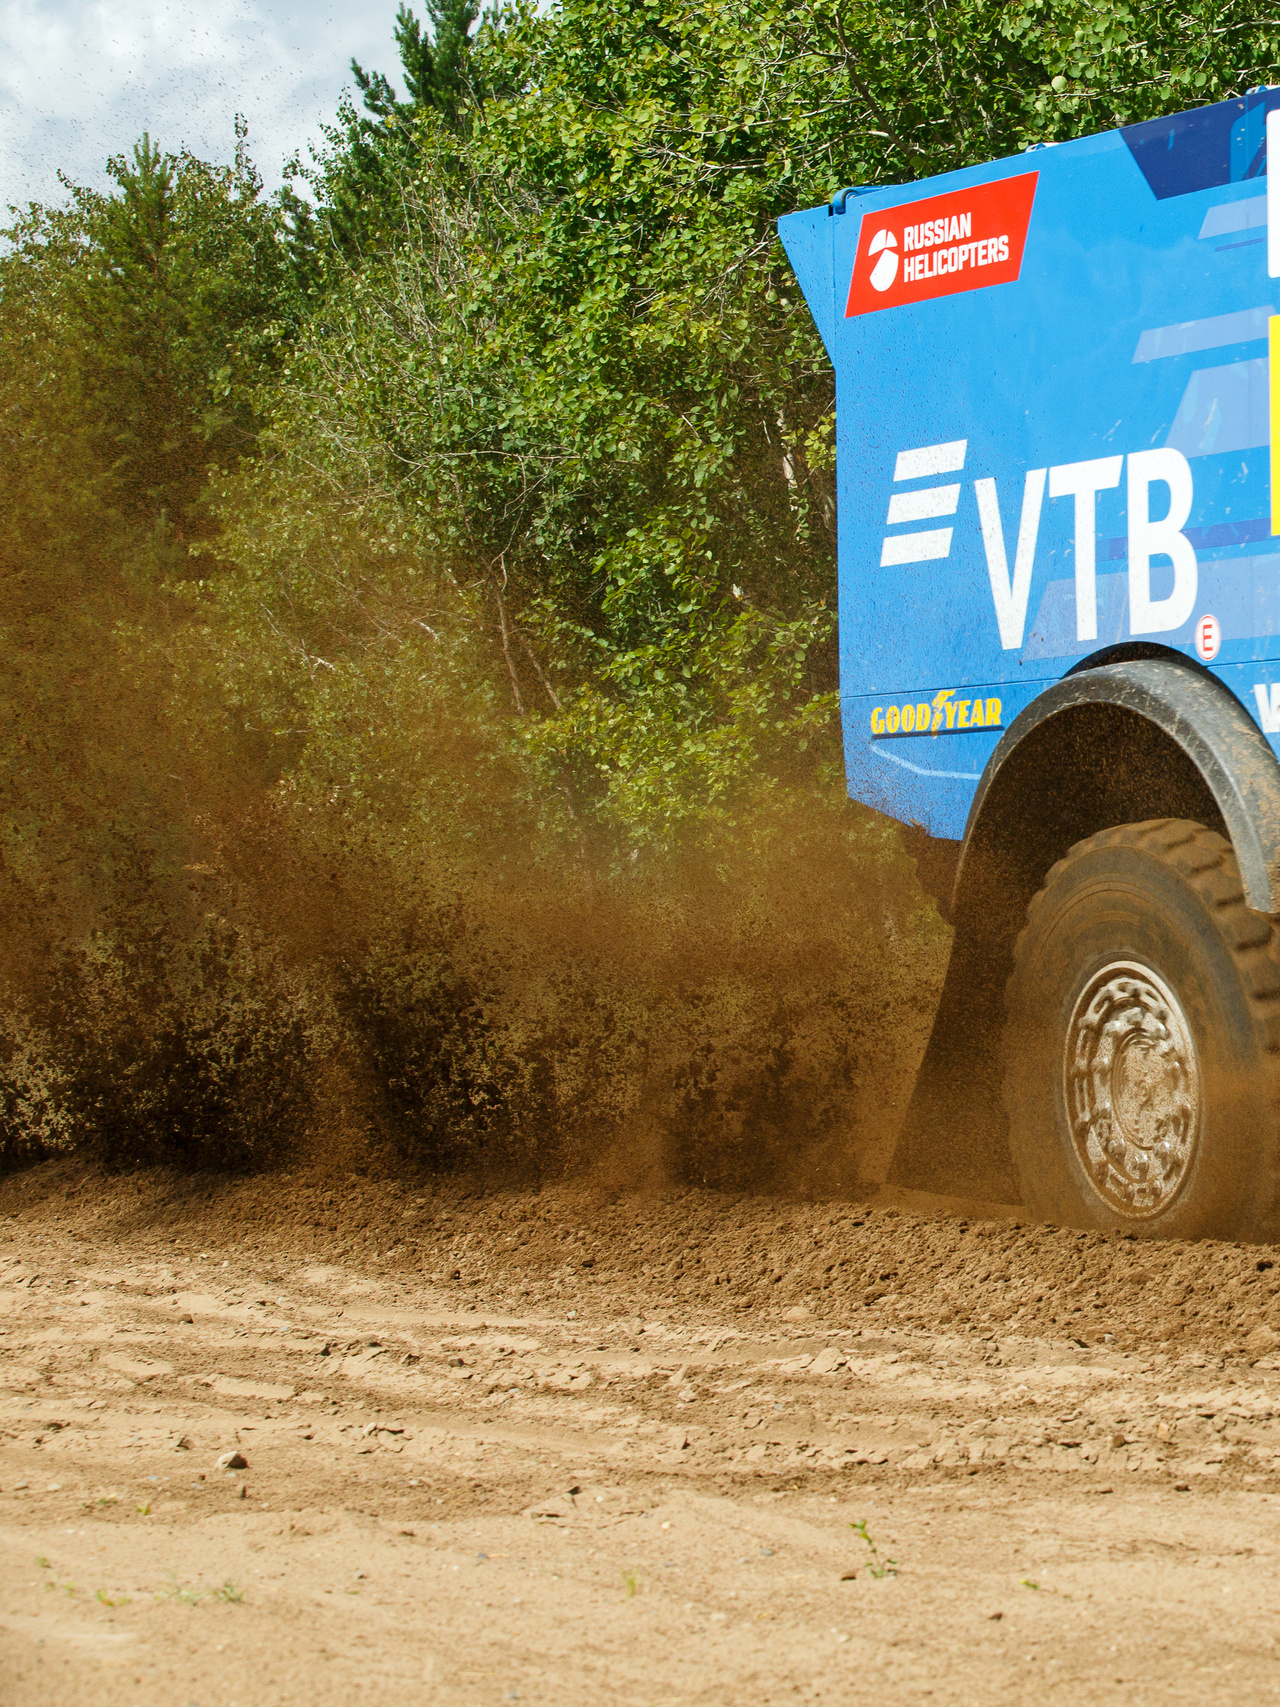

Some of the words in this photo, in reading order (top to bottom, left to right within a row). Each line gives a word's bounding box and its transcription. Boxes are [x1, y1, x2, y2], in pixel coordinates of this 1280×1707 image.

[904, 212, 972, 251] RUSSIAN
[903, 234, 1009, 283] HELICOPTERS
[974, 447, 1199, 650] VTB
[1203, 624, 1213, 651] E
[871, 692, 1002, 736] GOODYEAR
